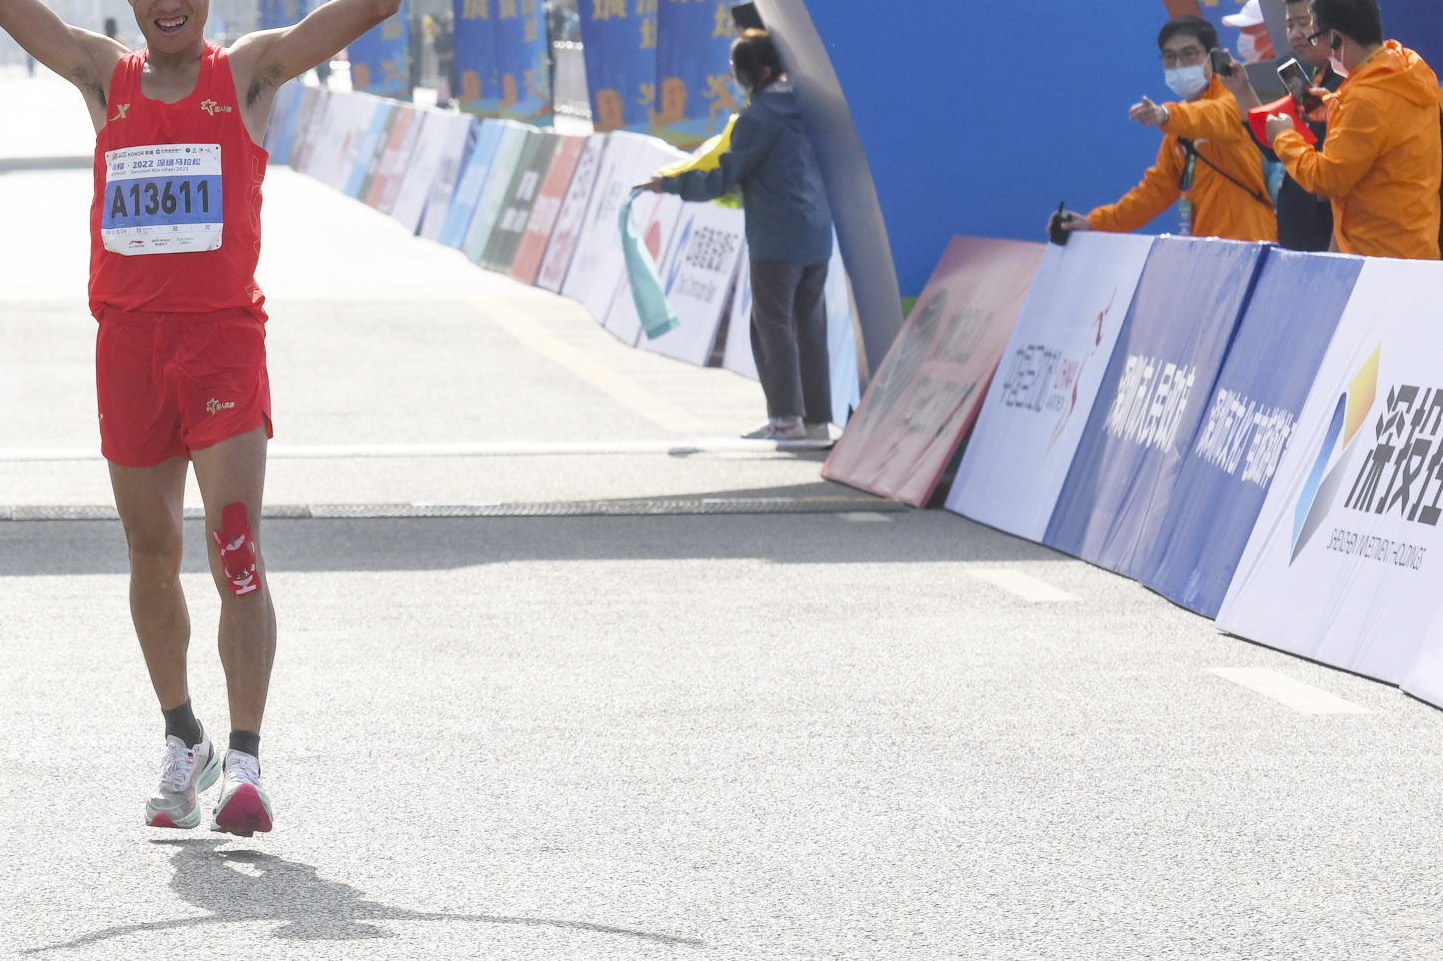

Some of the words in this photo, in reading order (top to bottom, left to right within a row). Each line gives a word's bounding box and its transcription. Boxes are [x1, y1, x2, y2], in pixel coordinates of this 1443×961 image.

[132, 160, 154, 170] 2022
[157, 158, 201, 168] 深圳马拉松
[111, 178, 210, 220] A13611
